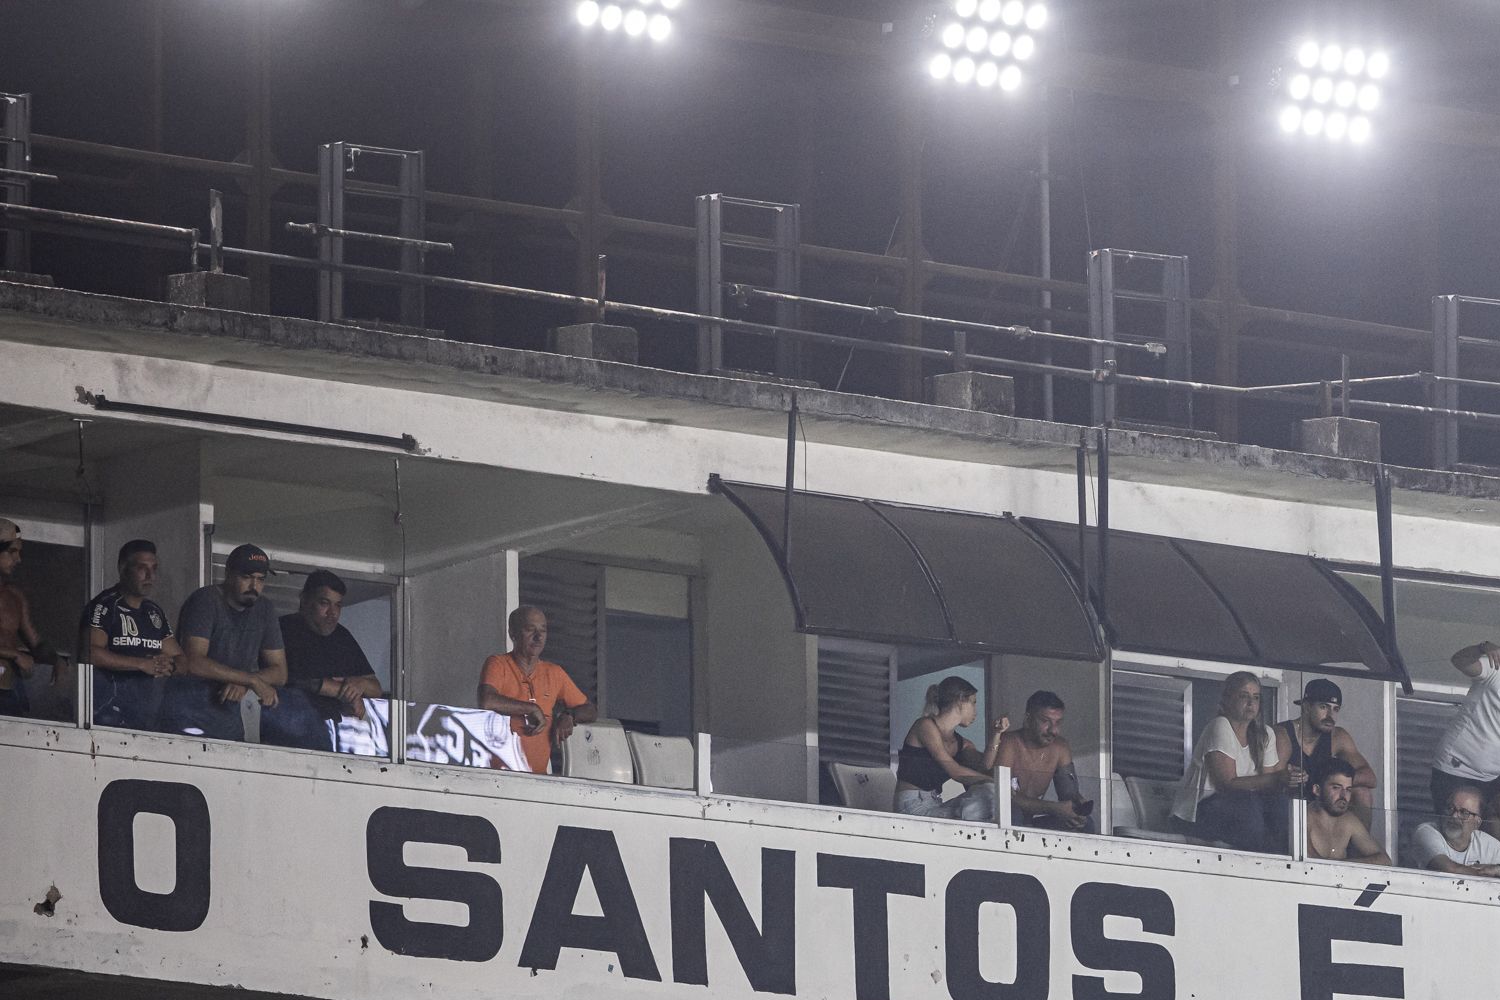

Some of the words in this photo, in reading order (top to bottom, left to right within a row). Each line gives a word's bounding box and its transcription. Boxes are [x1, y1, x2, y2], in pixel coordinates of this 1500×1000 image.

[119, 613, 139, 637] 10
[112, 636, 141, 647] SEMP
[98, 779, 210, 931] O
